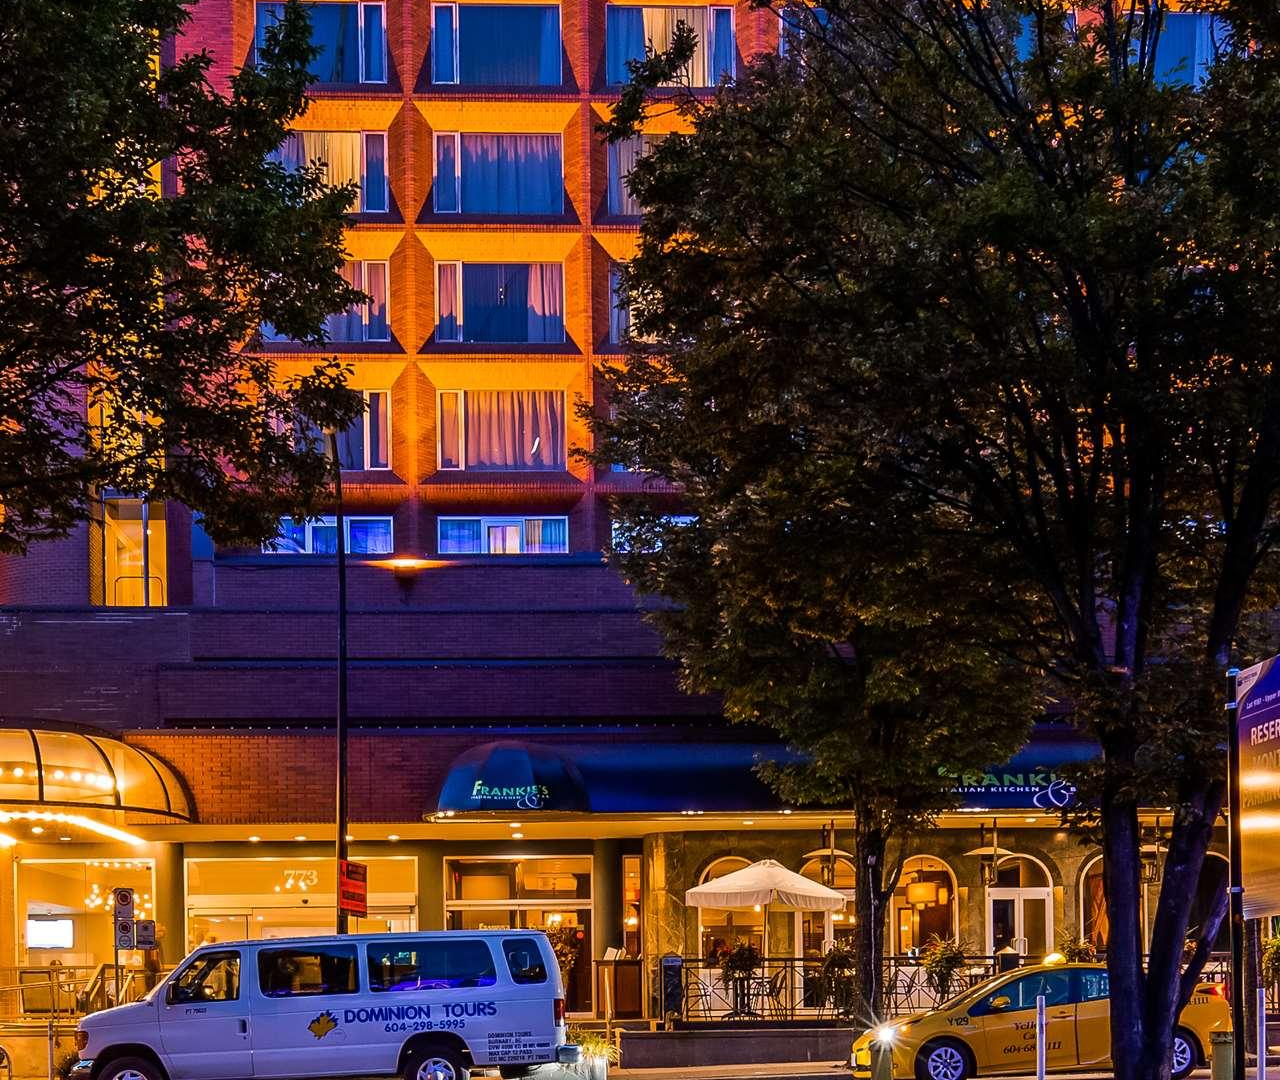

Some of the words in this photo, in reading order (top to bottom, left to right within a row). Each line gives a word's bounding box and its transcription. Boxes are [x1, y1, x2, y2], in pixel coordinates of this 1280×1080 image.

[283, 869, 318, 887] 773
[344, 1006, 431, 1024] DOMINION
[443, 1002, 497, 1017] TOURS
[384, 1019, 466, 1033] 604-298-5995
